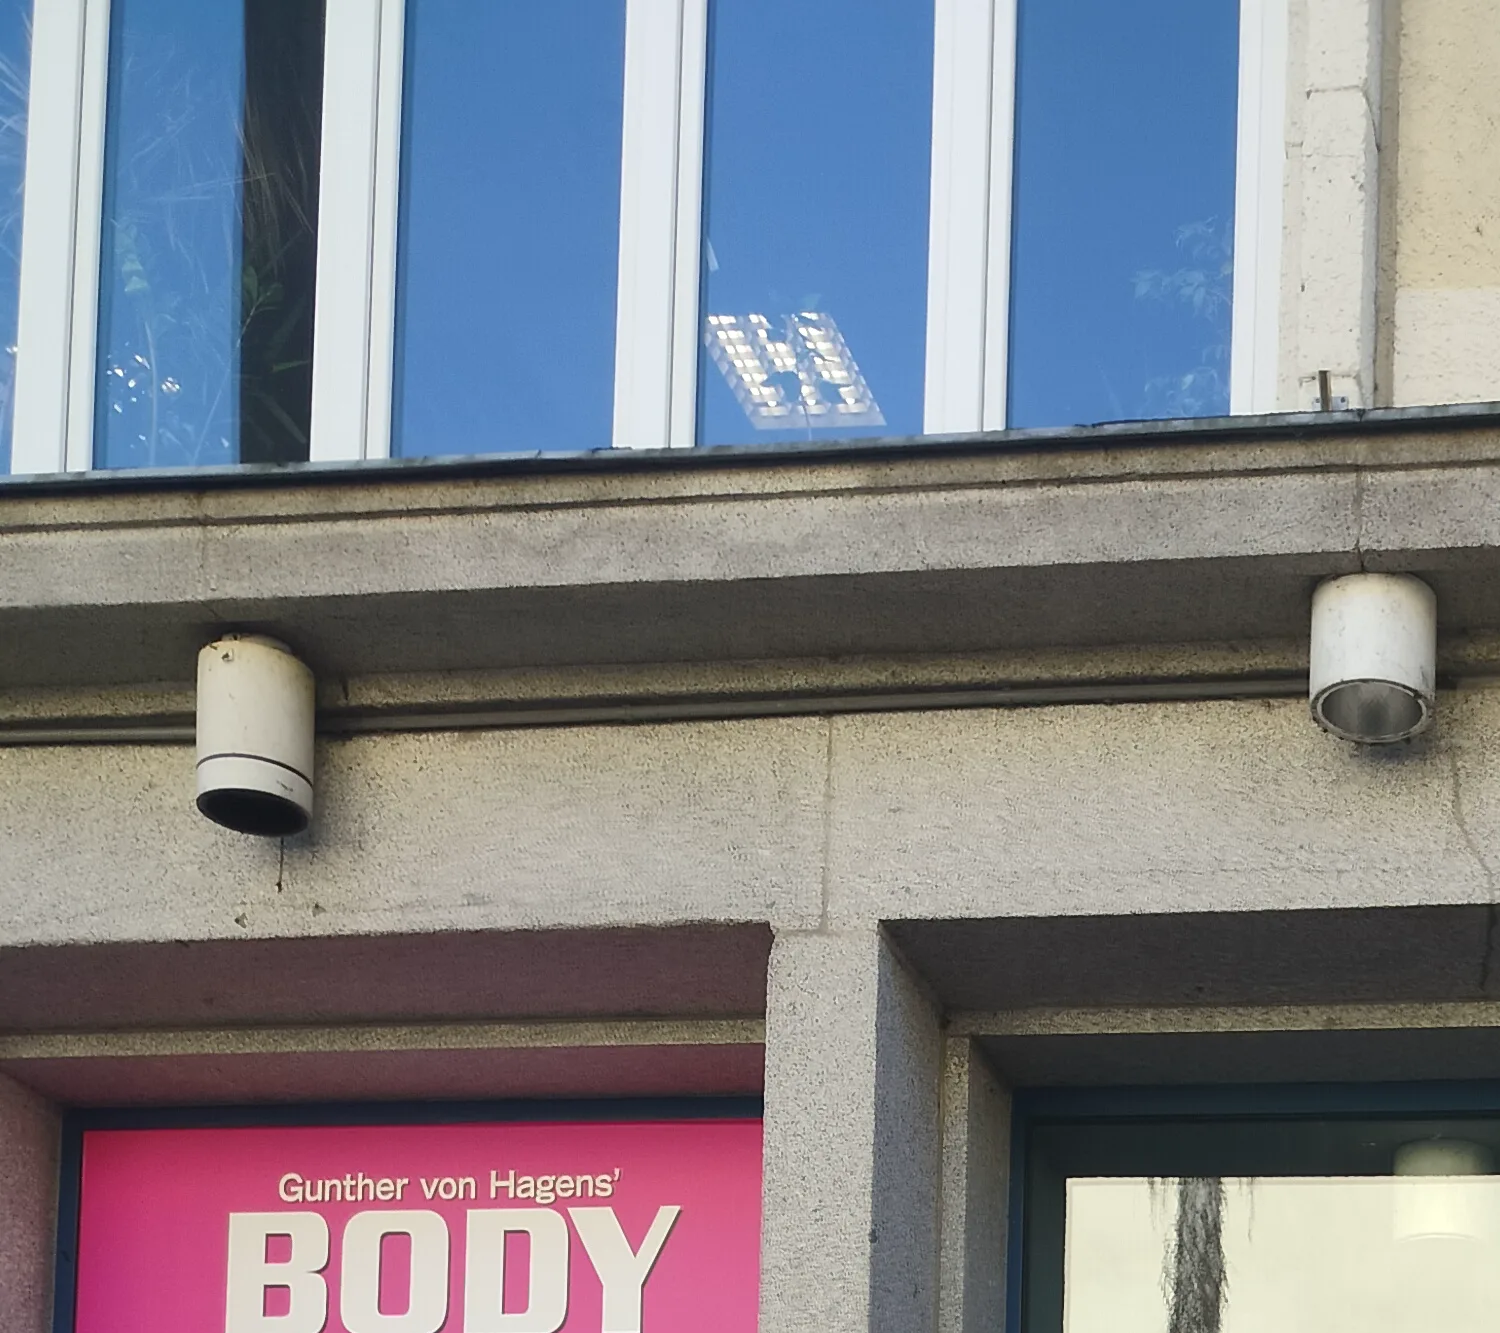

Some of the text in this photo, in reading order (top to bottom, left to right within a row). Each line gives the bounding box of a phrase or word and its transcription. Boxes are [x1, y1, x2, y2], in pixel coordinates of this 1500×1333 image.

[279, 1168, 620, 1205] Gunther von Hagens'
